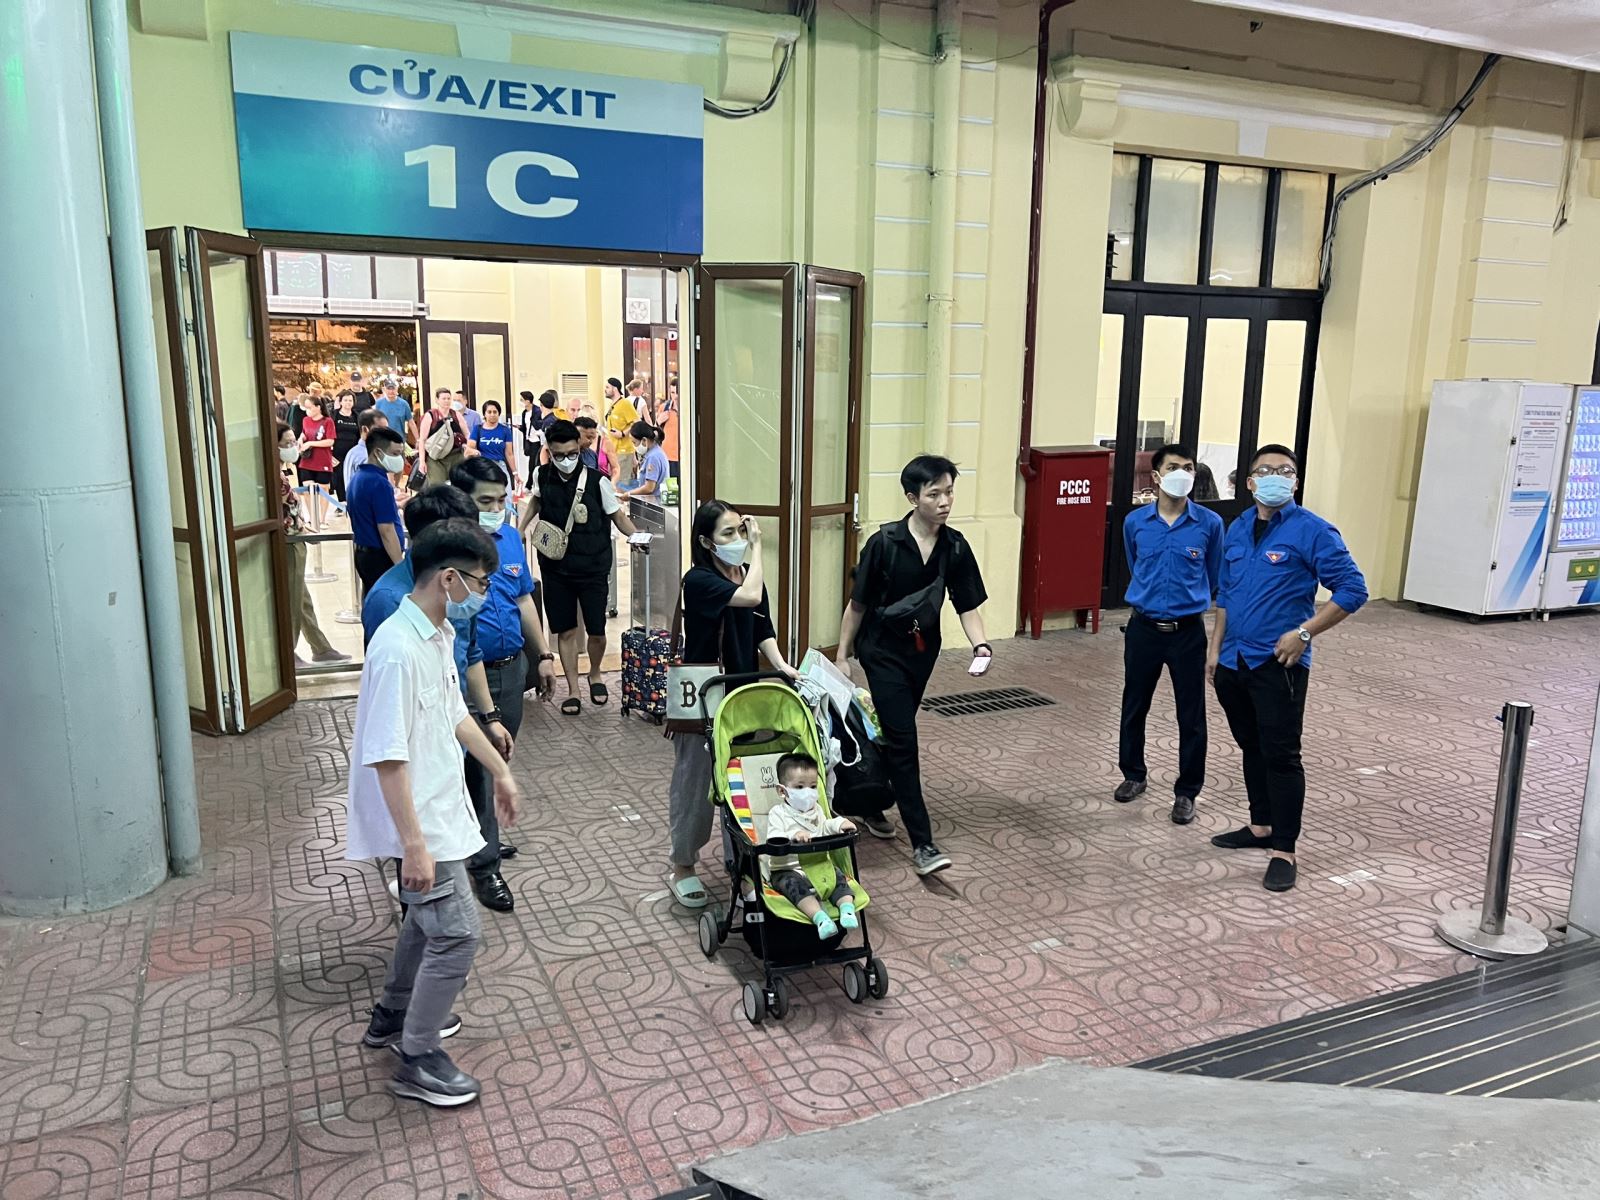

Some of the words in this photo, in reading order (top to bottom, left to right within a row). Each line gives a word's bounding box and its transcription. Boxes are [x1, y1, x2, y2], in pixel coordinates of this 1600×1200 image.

[348, 58, 617, 120] CỬA/EXIT
[1060, 479, 1090, 495] PCCC
[1056, 497, 1067, 505] FIRE
[1068, 496, 1080, 504] HOSE
[1080, 496, 1091, 504] REEL
[680, 680, 697, 708] B
